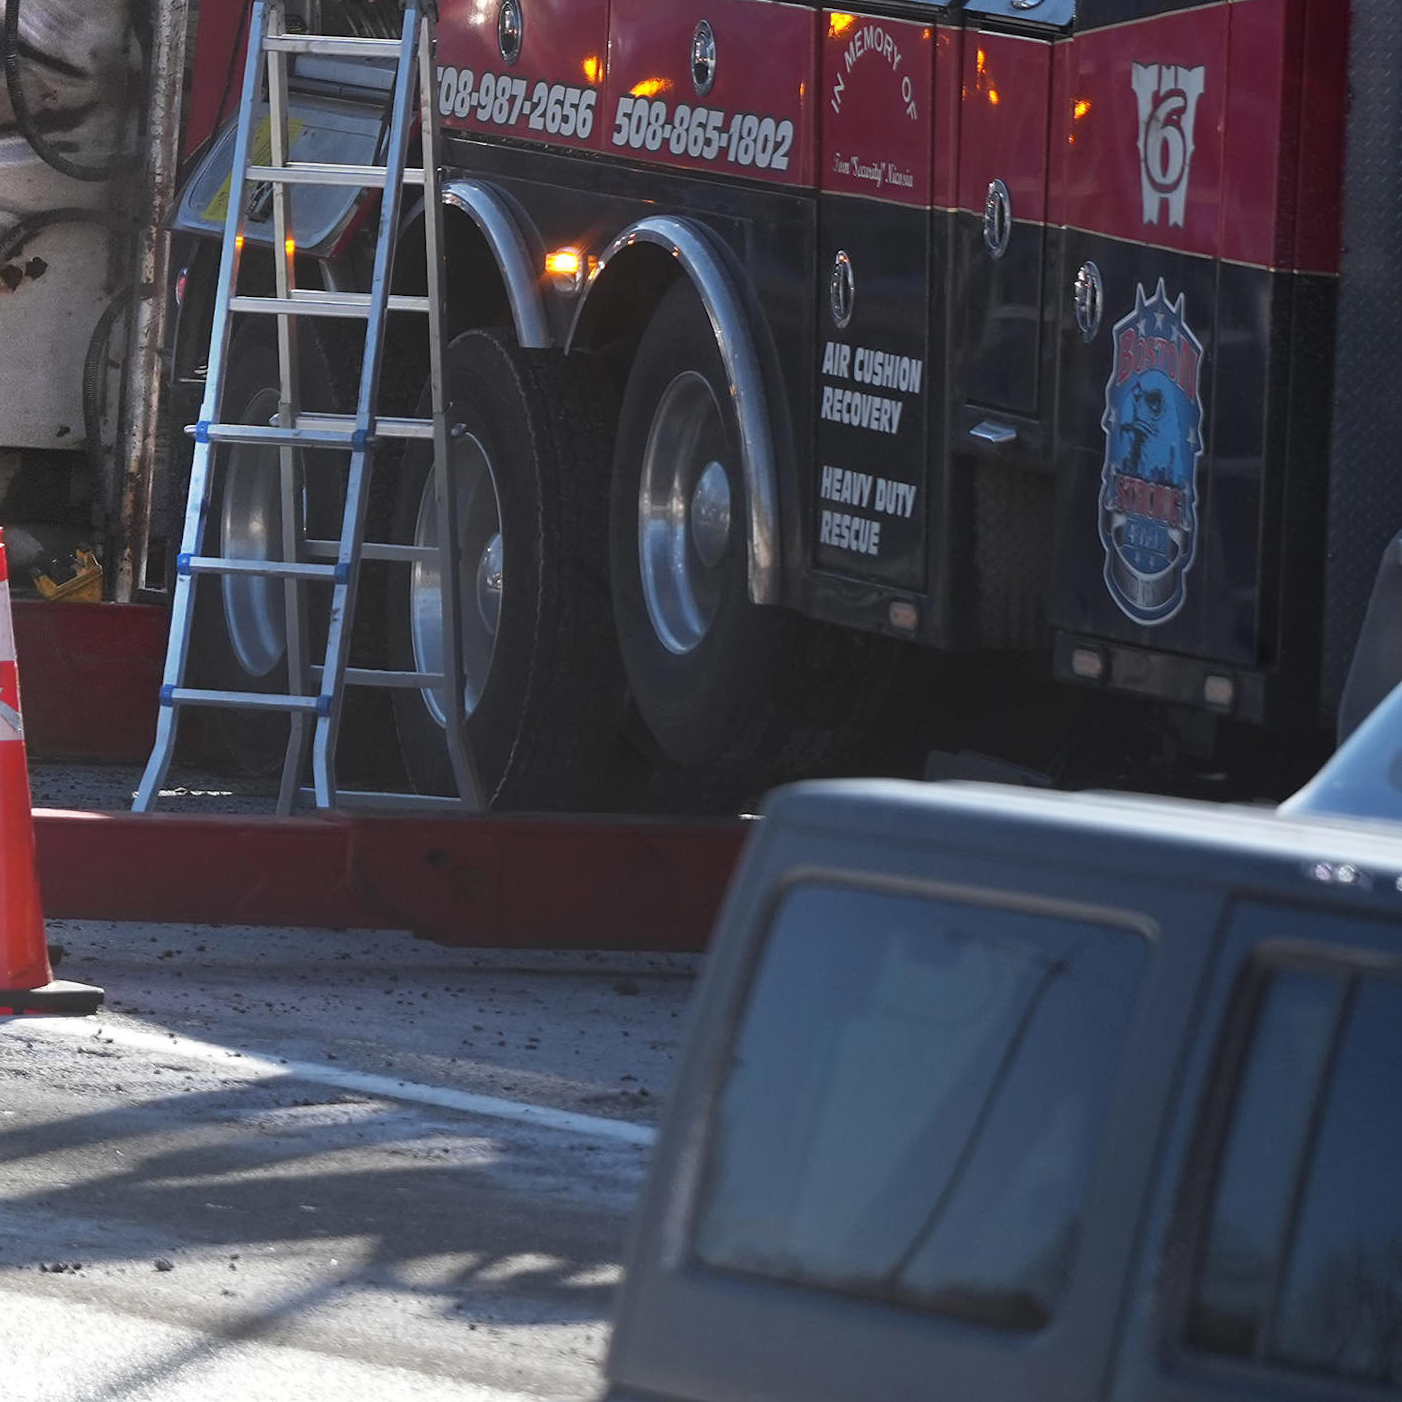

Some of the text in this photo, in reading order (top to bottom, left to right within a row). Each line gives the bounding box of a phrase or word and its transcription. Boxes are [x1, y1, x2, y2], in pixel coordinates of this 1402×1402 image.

[830, 24, 919, 121] IN MEMORY OF
[436, 65, 794, 171] 08-987-2656 508-865-1802
[821, 341, 924, 394] AIR CUSHION
[820, 386, 904, 435] RECOVERY
[820, 465, 917, 519] HEAVY DUTY
[819, 509, 882, 556] RESCUE
